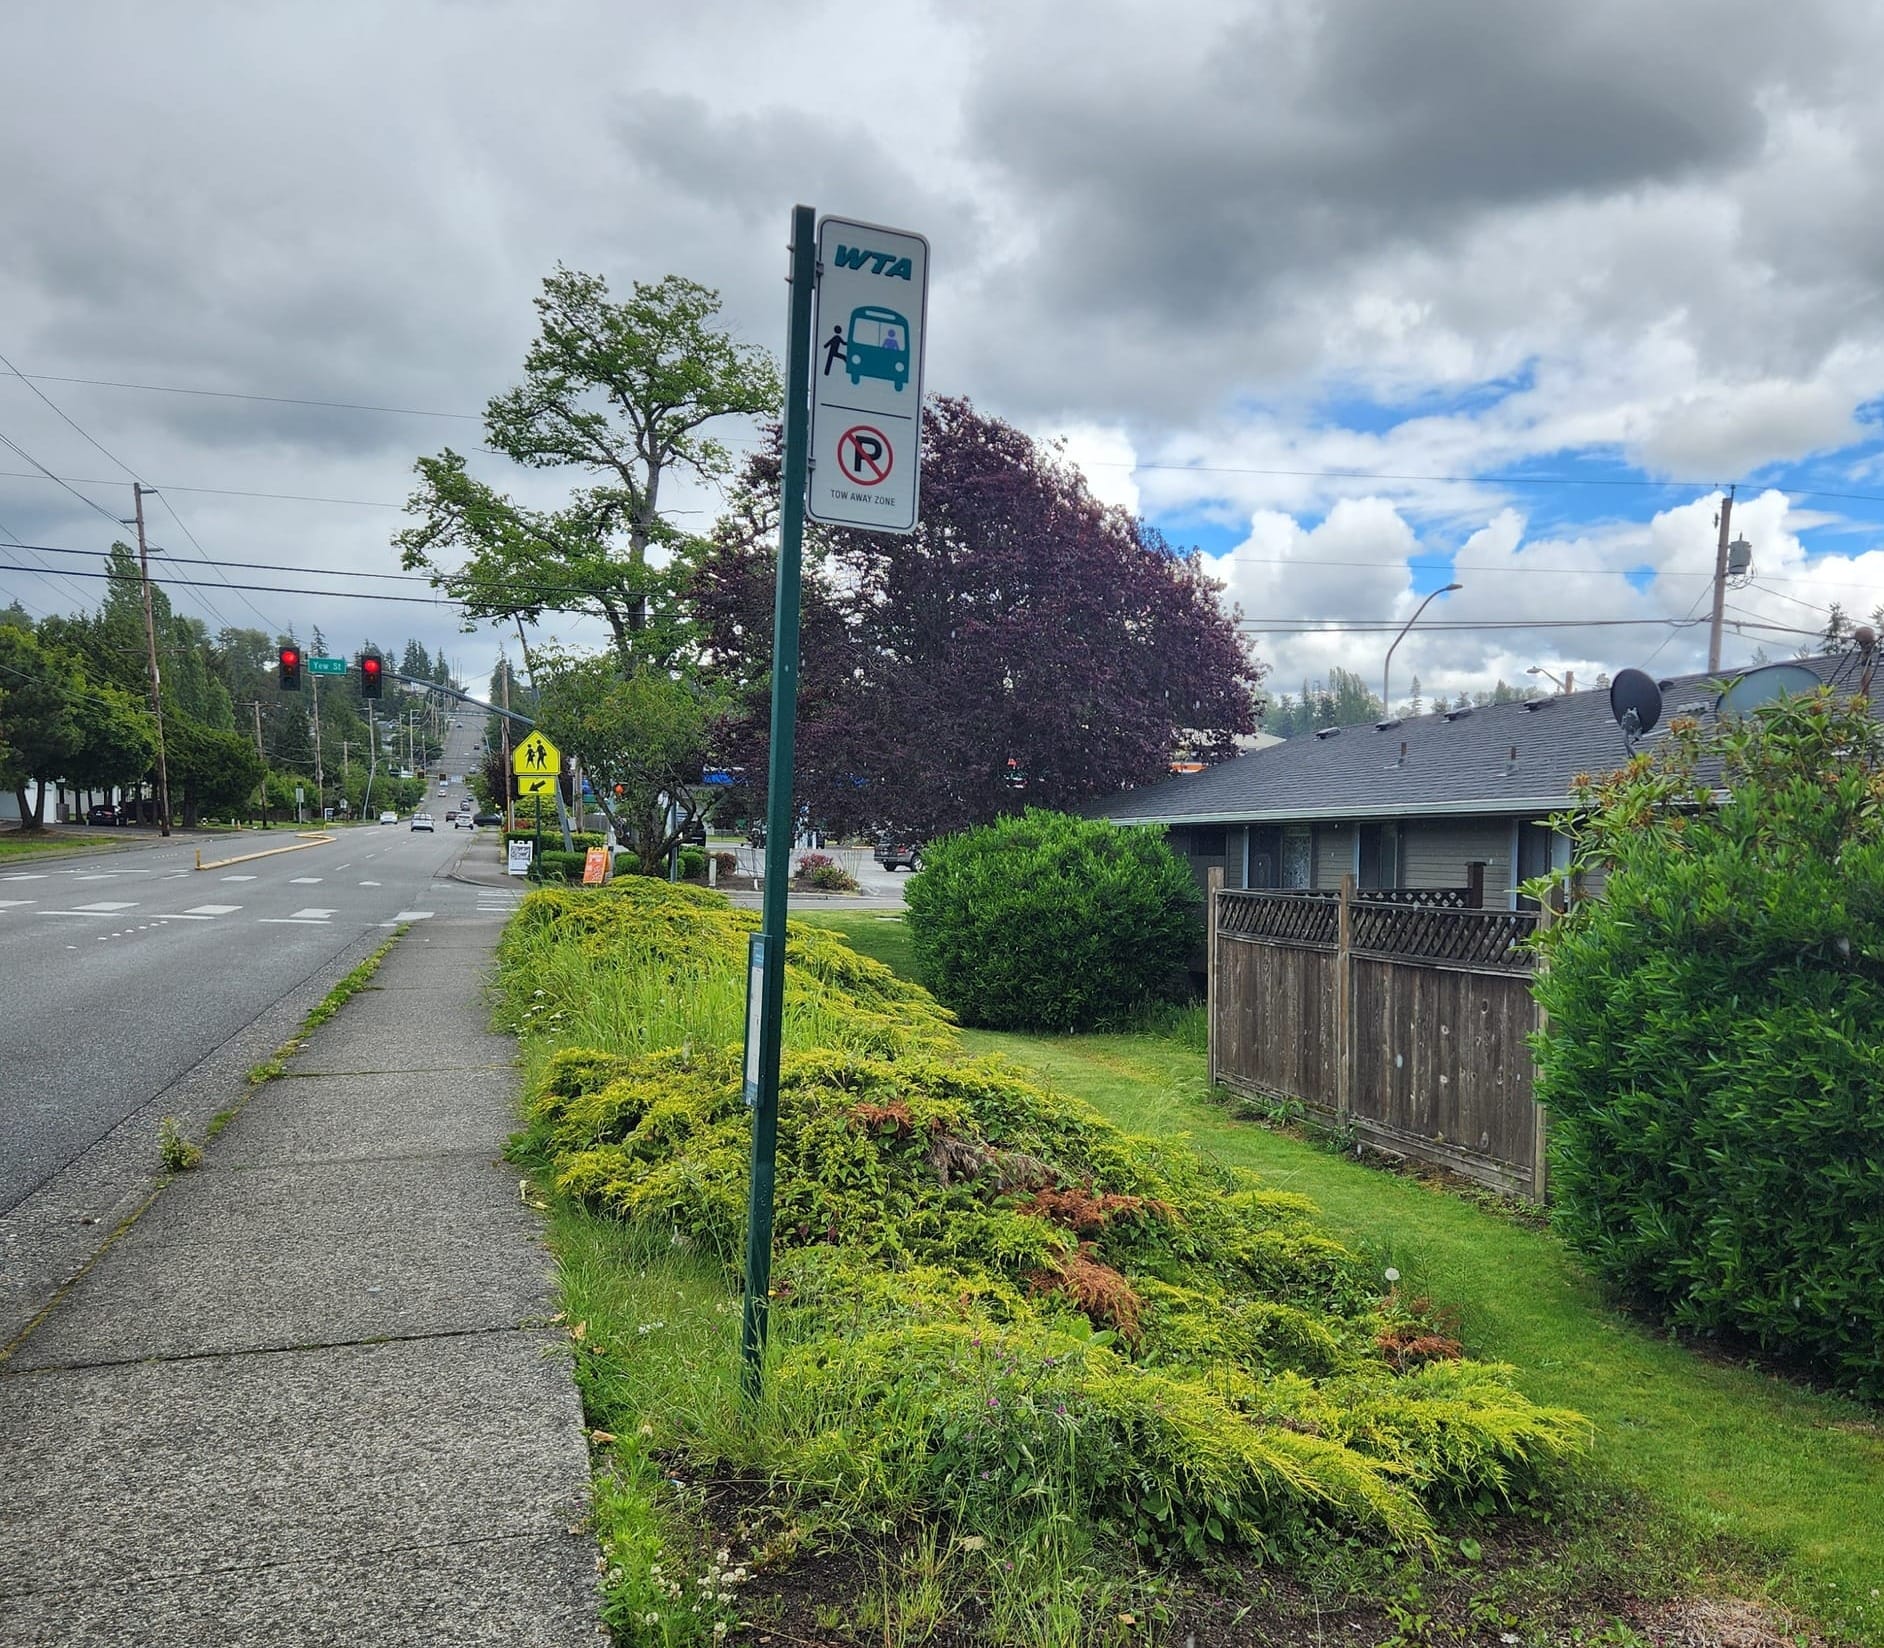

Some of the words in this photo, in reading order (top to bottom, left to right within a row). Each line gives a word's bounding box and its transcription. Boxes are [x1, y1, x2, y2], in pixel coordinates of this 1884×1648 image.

[834, 244, 912, 281] WTA
[854, 435, 882, 472] P
[831, 489, 848, 500] TOW
[850, 492, 872, 503] AWAY
[874, 495, 896, 507] ZONE
[313, 661, 330, 670] Yew
[333, 662, 342, 671] St
